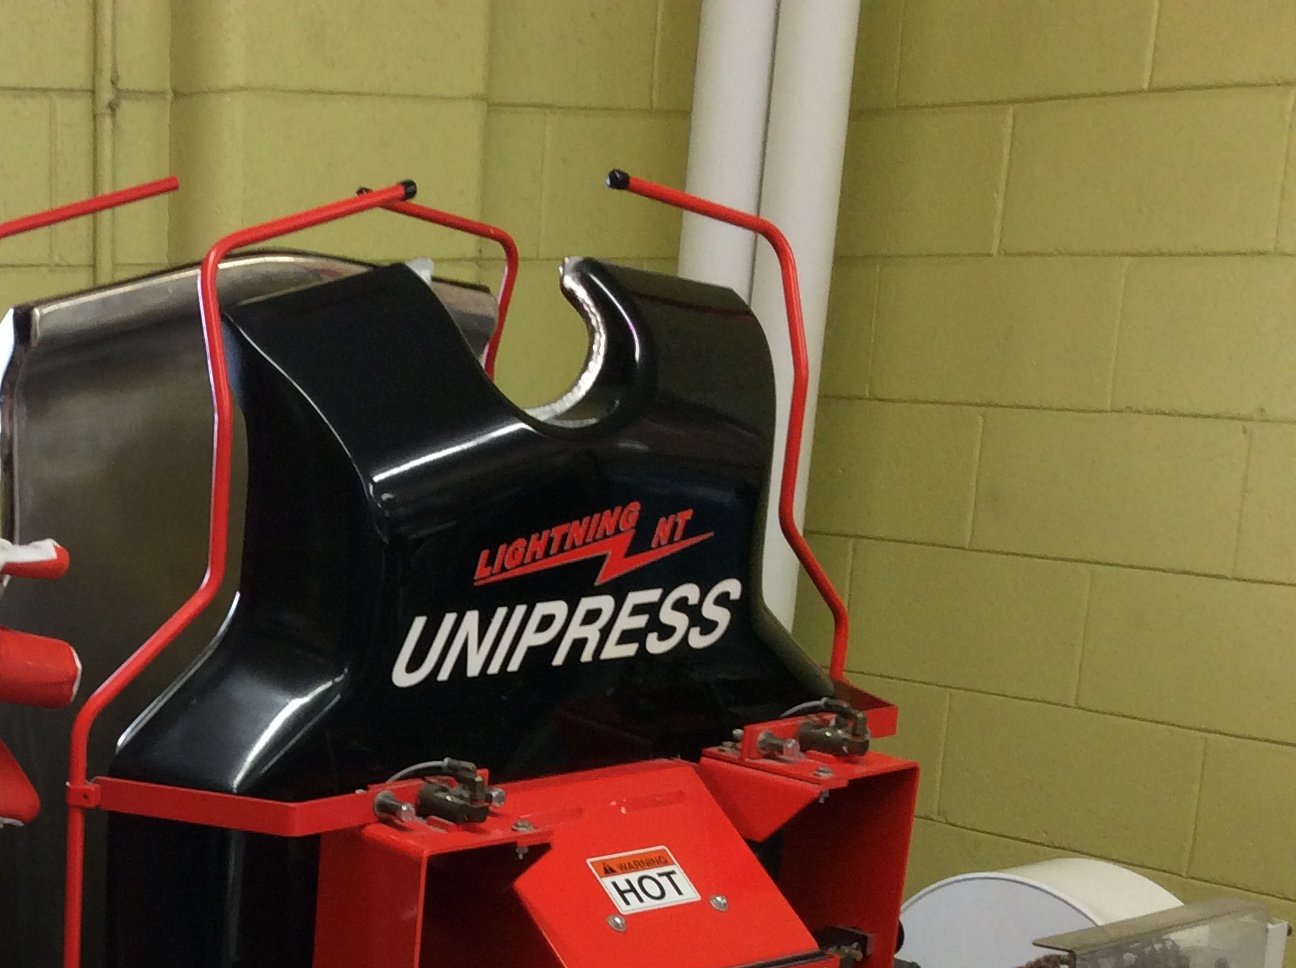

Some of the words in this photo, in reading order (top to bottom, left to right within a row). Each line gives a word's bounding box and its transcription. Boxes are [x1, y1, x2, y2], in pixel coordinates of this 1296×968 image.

[475, 501, 641, 580] LIGHTNING
[651, 508, 694, 548] NT
[391, 578, 742, 688] UNIPRESS
[611, 870, 684, 906] HOT
[617, 855, 668, 872] WARNING
